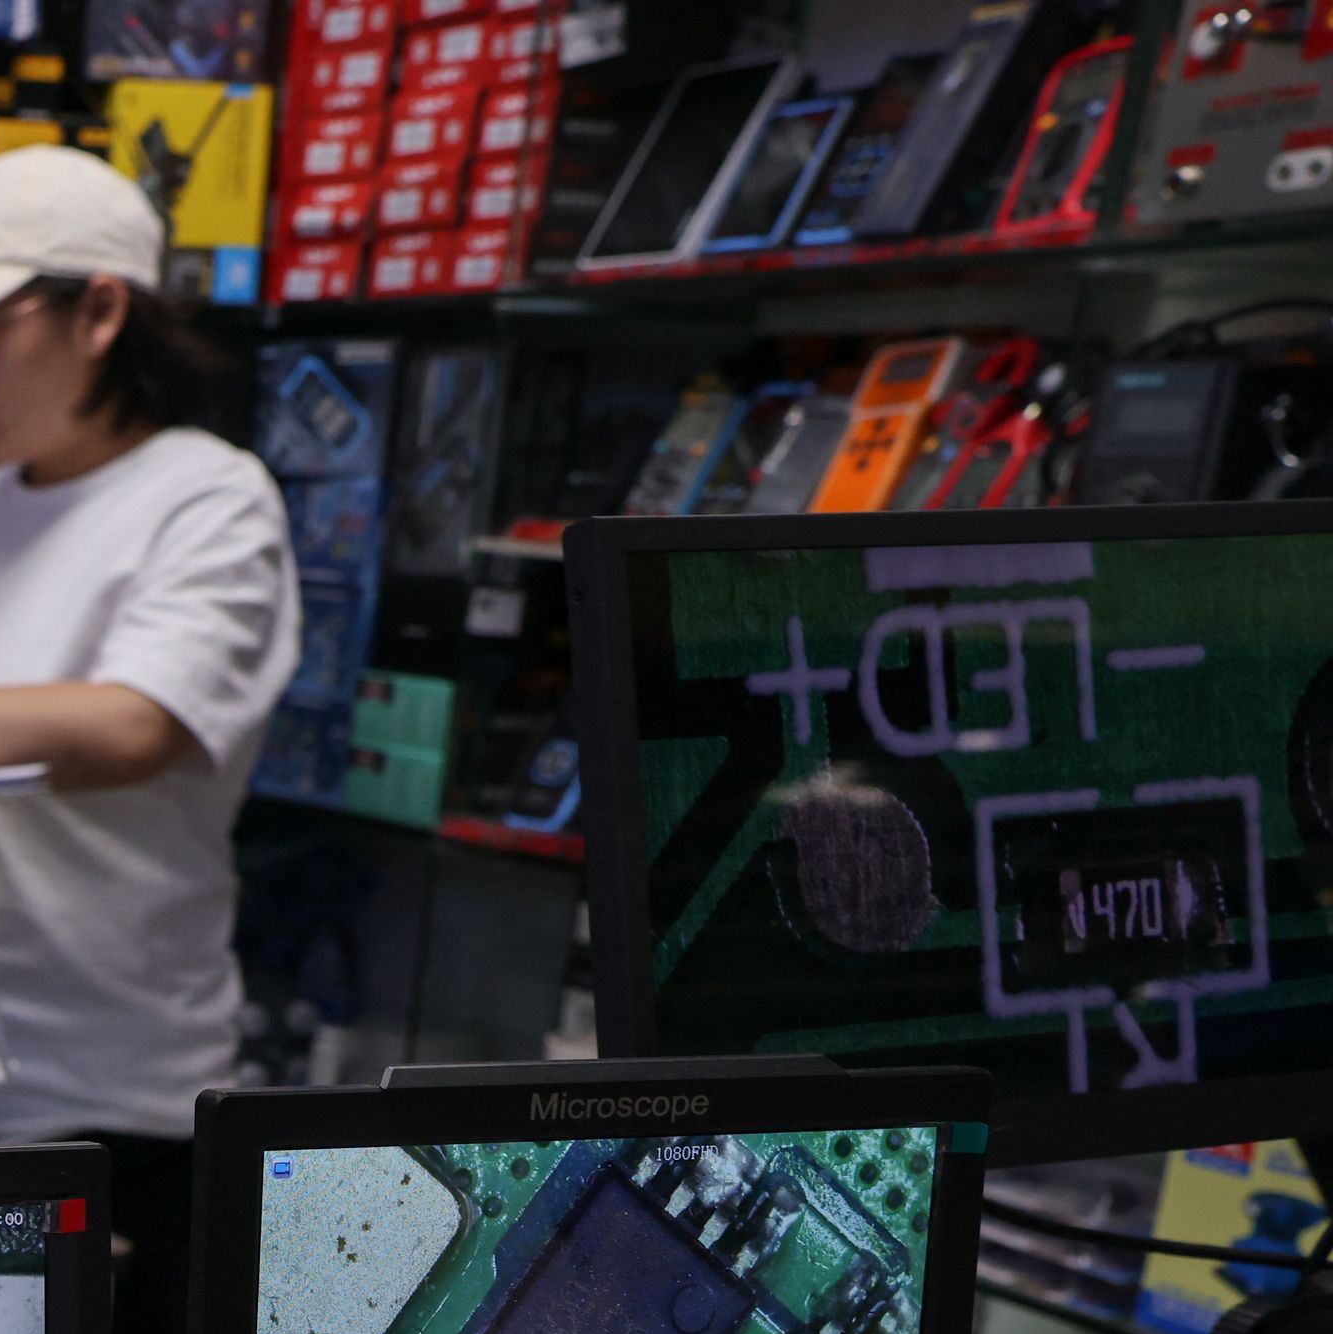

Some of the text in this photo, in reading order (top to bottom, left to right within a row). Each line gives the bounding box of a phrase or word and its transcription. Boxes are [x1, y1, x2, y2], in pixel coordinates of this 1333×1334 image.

[1092, 878, 1162, 941] 470
[530, 1092, 710, 1122] Microscope
[656, 1145, 719, 1162] 1080FHD
